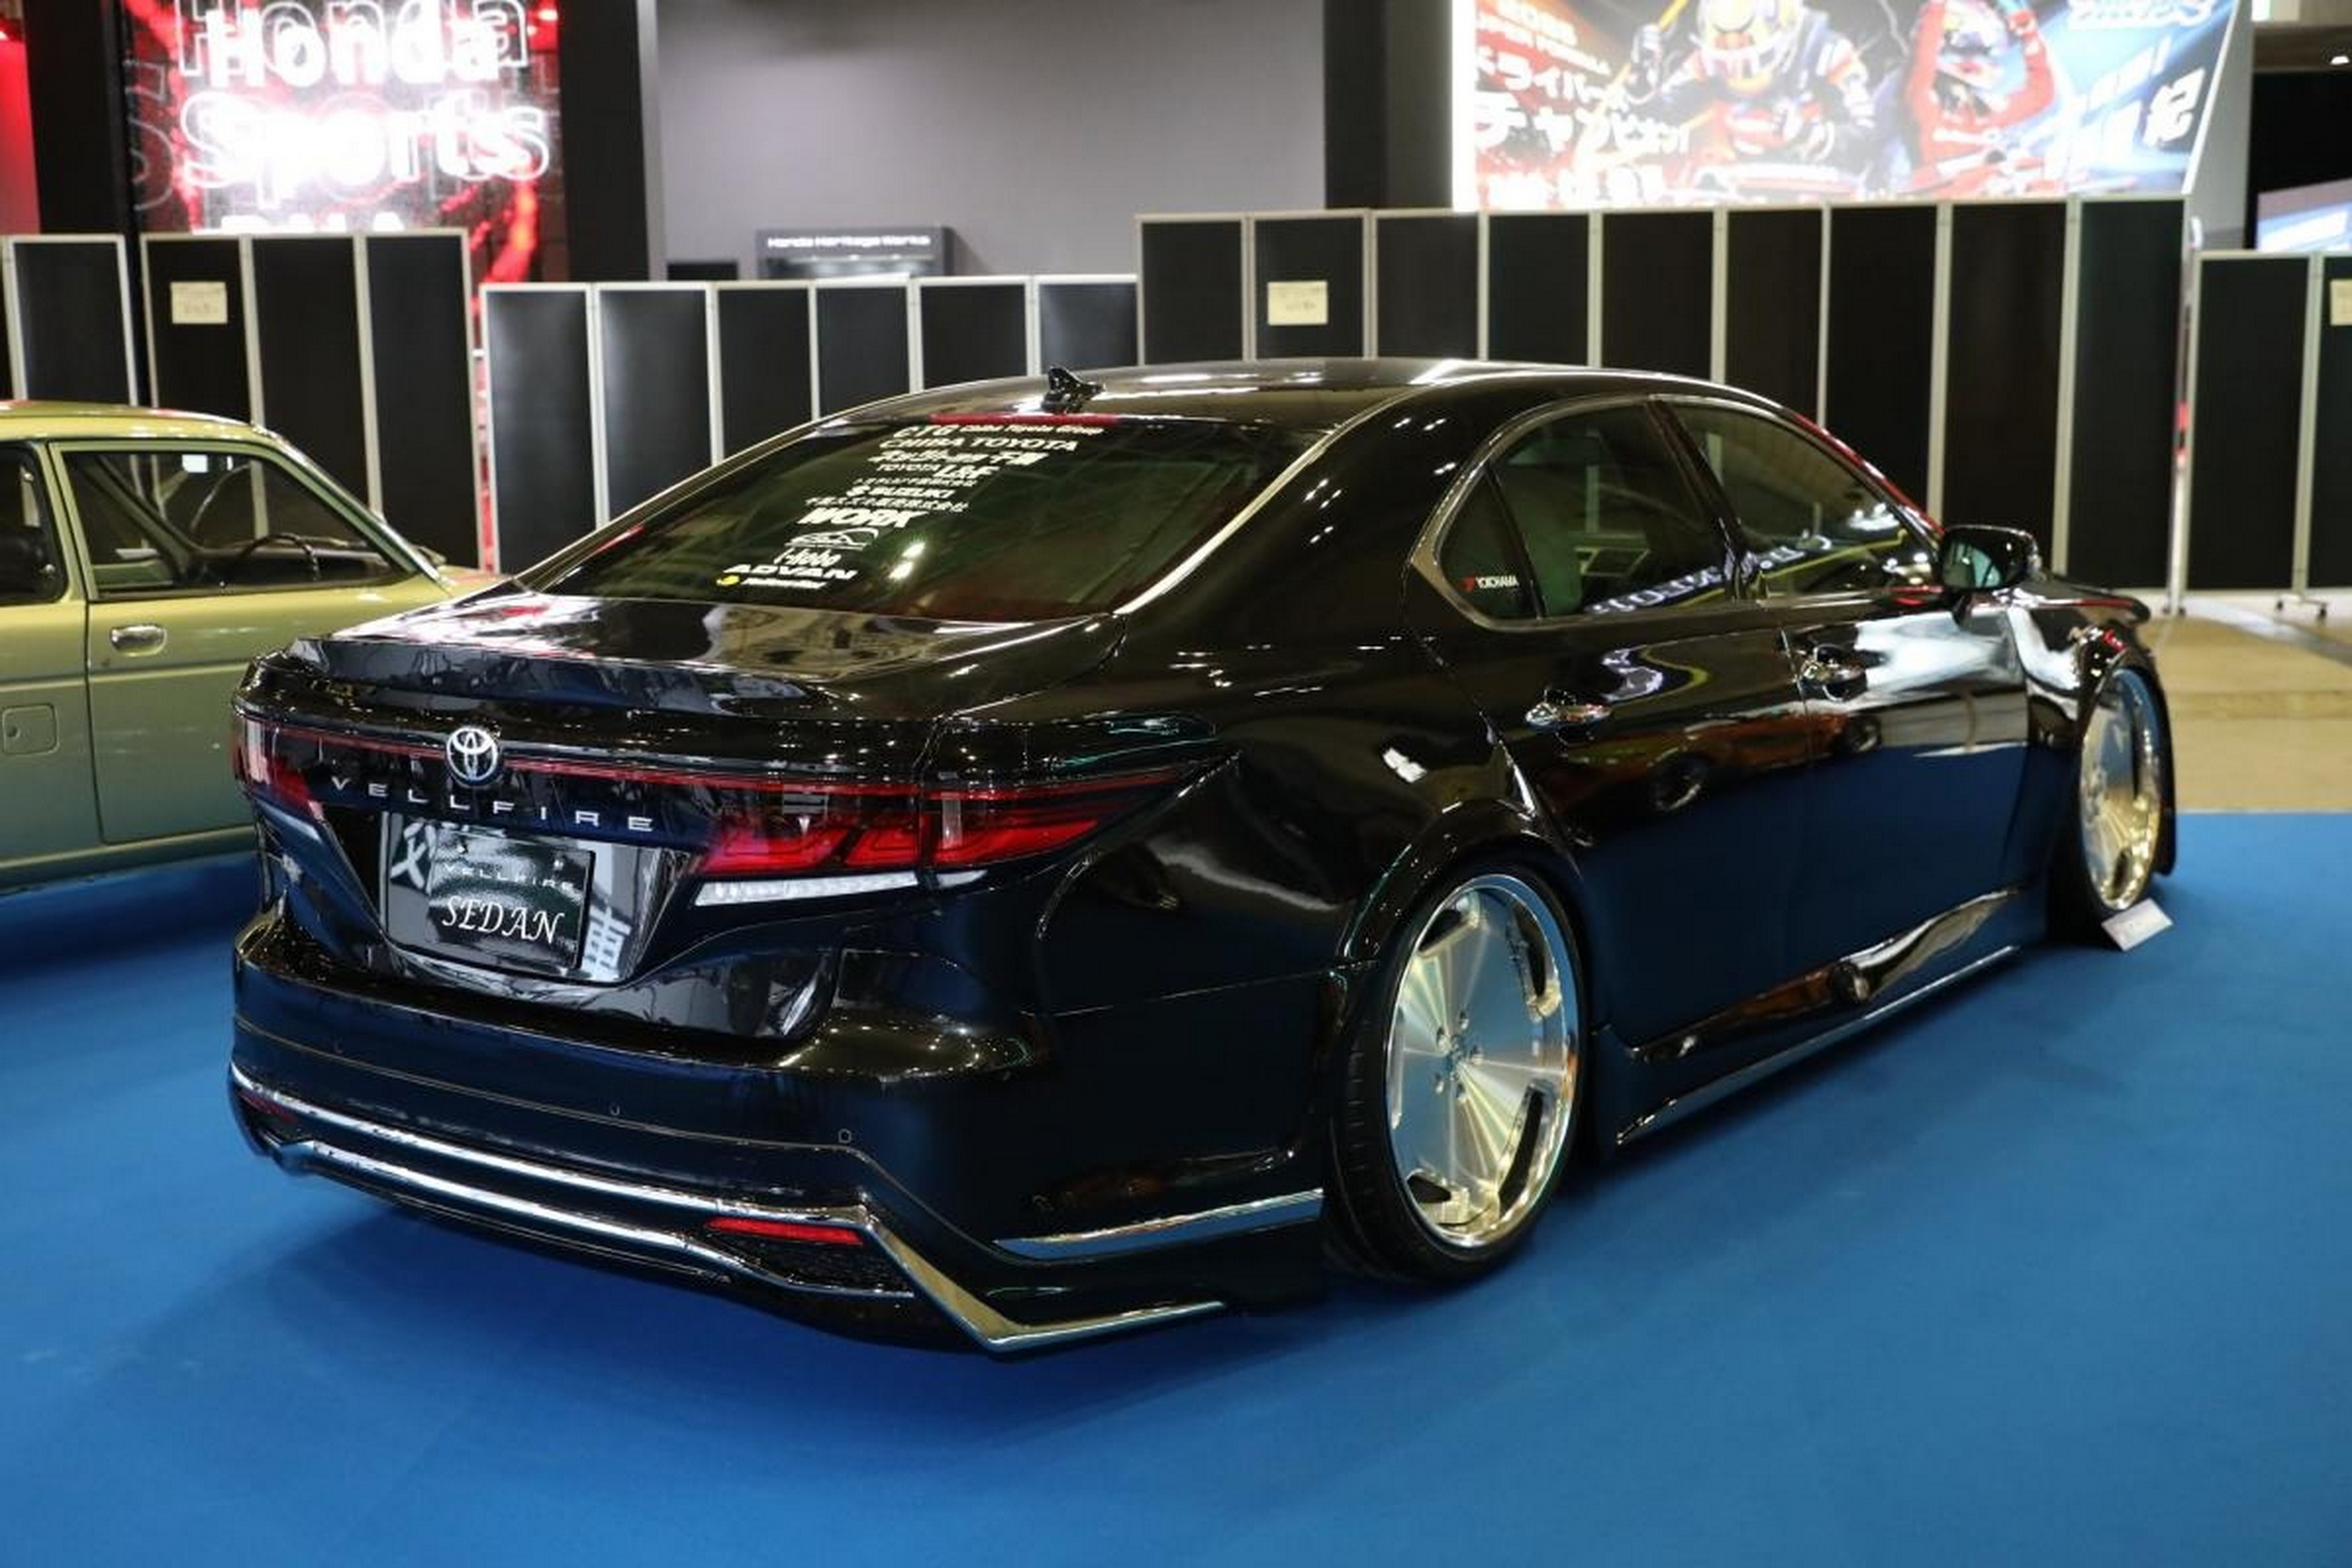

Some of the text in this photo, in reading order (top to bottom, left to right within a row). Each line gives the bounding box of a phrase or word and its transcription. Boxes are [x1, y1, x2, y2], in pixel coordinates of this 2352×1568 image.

[181, 0, 527, 87] Honda
[181, 92, 550, 209] Sports
[880, 437, 1079, 451] CHIBA TOYOTA
[797, 507, 930, 529] WORK
[723, 564, 858, 580] ADVAN
[331, 776, 655, 832] VELLFIRE
[442, 895, 564, 943] SEDAN
